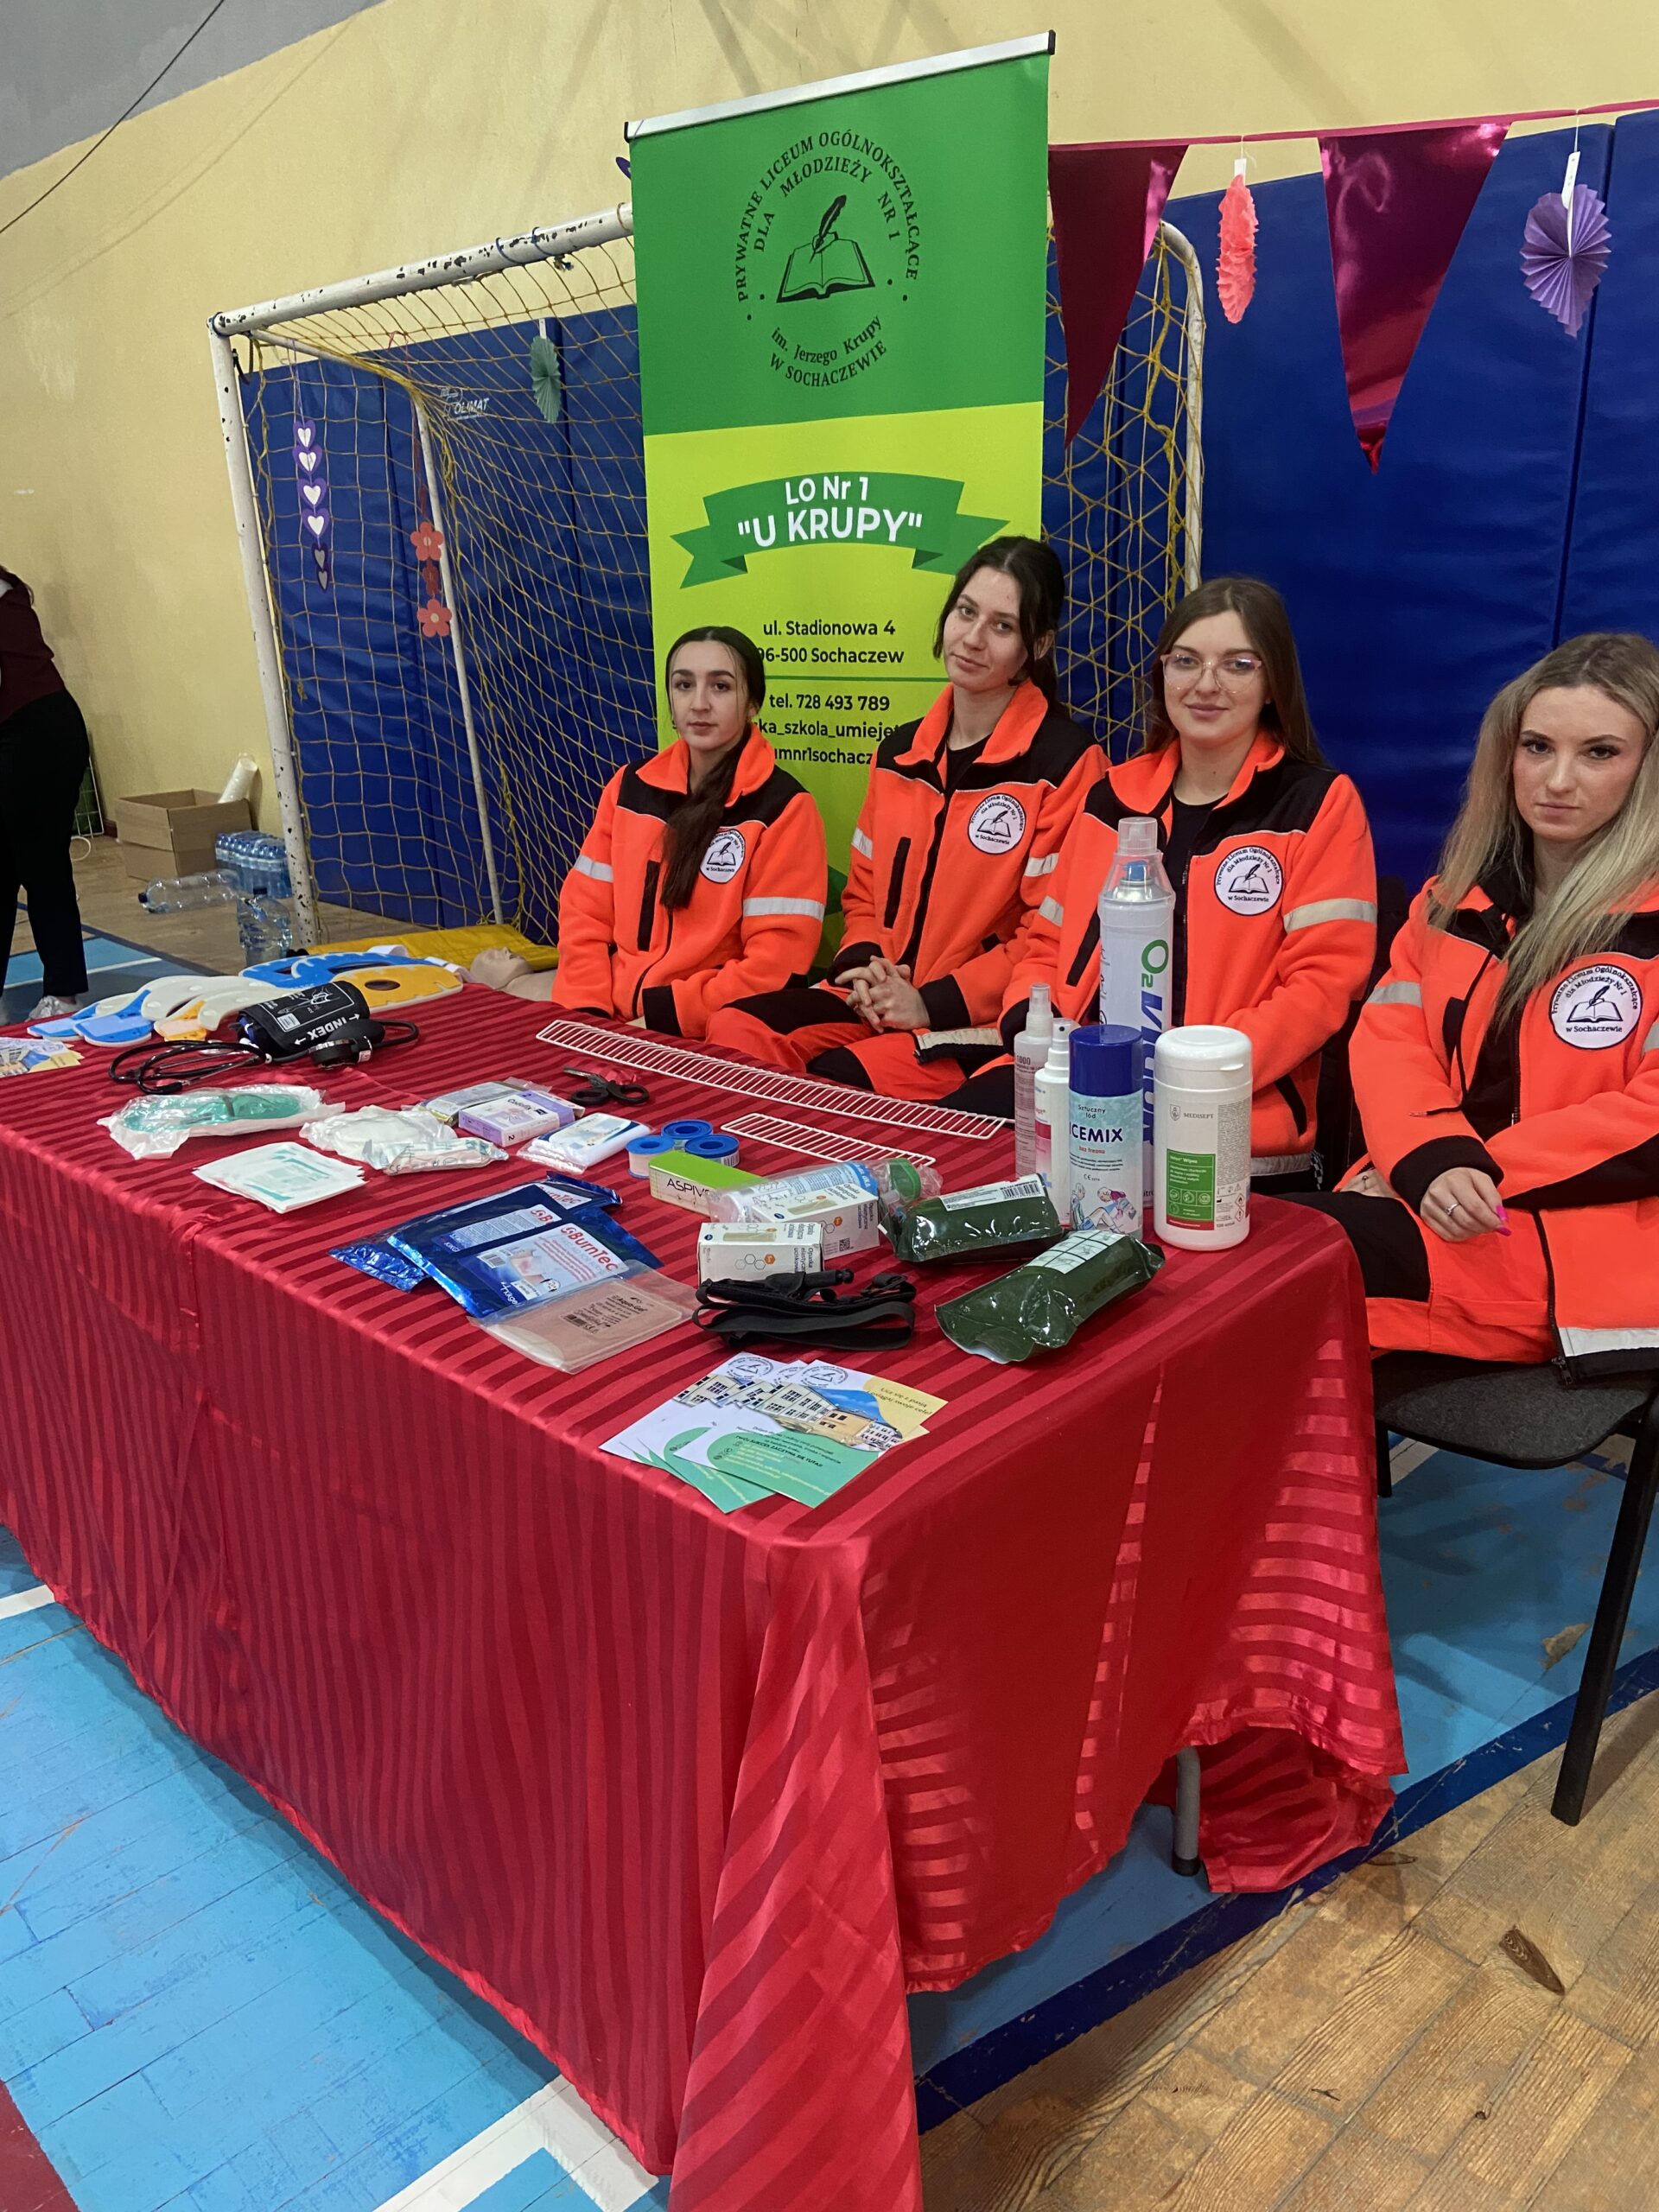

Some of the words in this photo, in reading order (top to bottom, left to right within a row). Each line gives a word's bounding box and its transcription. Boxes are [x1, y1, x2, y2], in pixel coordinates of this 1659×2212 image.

[753, 211, 775, 252] DLA
[779, 156, 873, 198] MŁODZIEŻY
[877, 191, 896, 224] NR
[735, 190, 763, 302] PRYWATNE
[760, 136, 813, 191] LICEUM
[819, 129, 920, 280] OGÓLNOKSZTAŁCĄCE
[772, 327, 788, 352] im.
[794, 344, 837, 365] Jerzego
[843, 315, 882, 355] Krupy
[769, 353, 783, 372] W
[785, 340, 887, 387] SOCHACZEWIE
[785, 478, 816, 505] LO
[823, 476, 851, 500] Nr
[858, 477, 868, 501] 1
[738, 515, 776, 547] "U
[787, 506, 923, 543] KRUPY"
[763, 620, 782, 636] ul.
[785, 619, 878, 635] Stadionowa
[883, 620, 896, 635] 4
[811, 647, 905, 664] Sochaczew
[768, 693, 792, 709] tel.
[796, 694, 821, 709] 728
[825, 695, 853, 710] 493
[857, 696, 890, 711] 789
[753, 718, 899, 741] ka_szkola_umieje
[1262, 861, 1270, 869] Nr
[1566, 969, 1593, 985] Liceum
[1565, 988, 1578, 998] dla
[1613, 980, 1624, 992] Nr
[307, 1016, 347, 1040] INDEX
[1078, 1104, 1106, 1114] Sztuczny
[1069, 1122, 1123, 1143] ICEMIX
[666, 1178, 711, 1198] ASPIV
[568, 1231, 619, 1272] BurnTec
